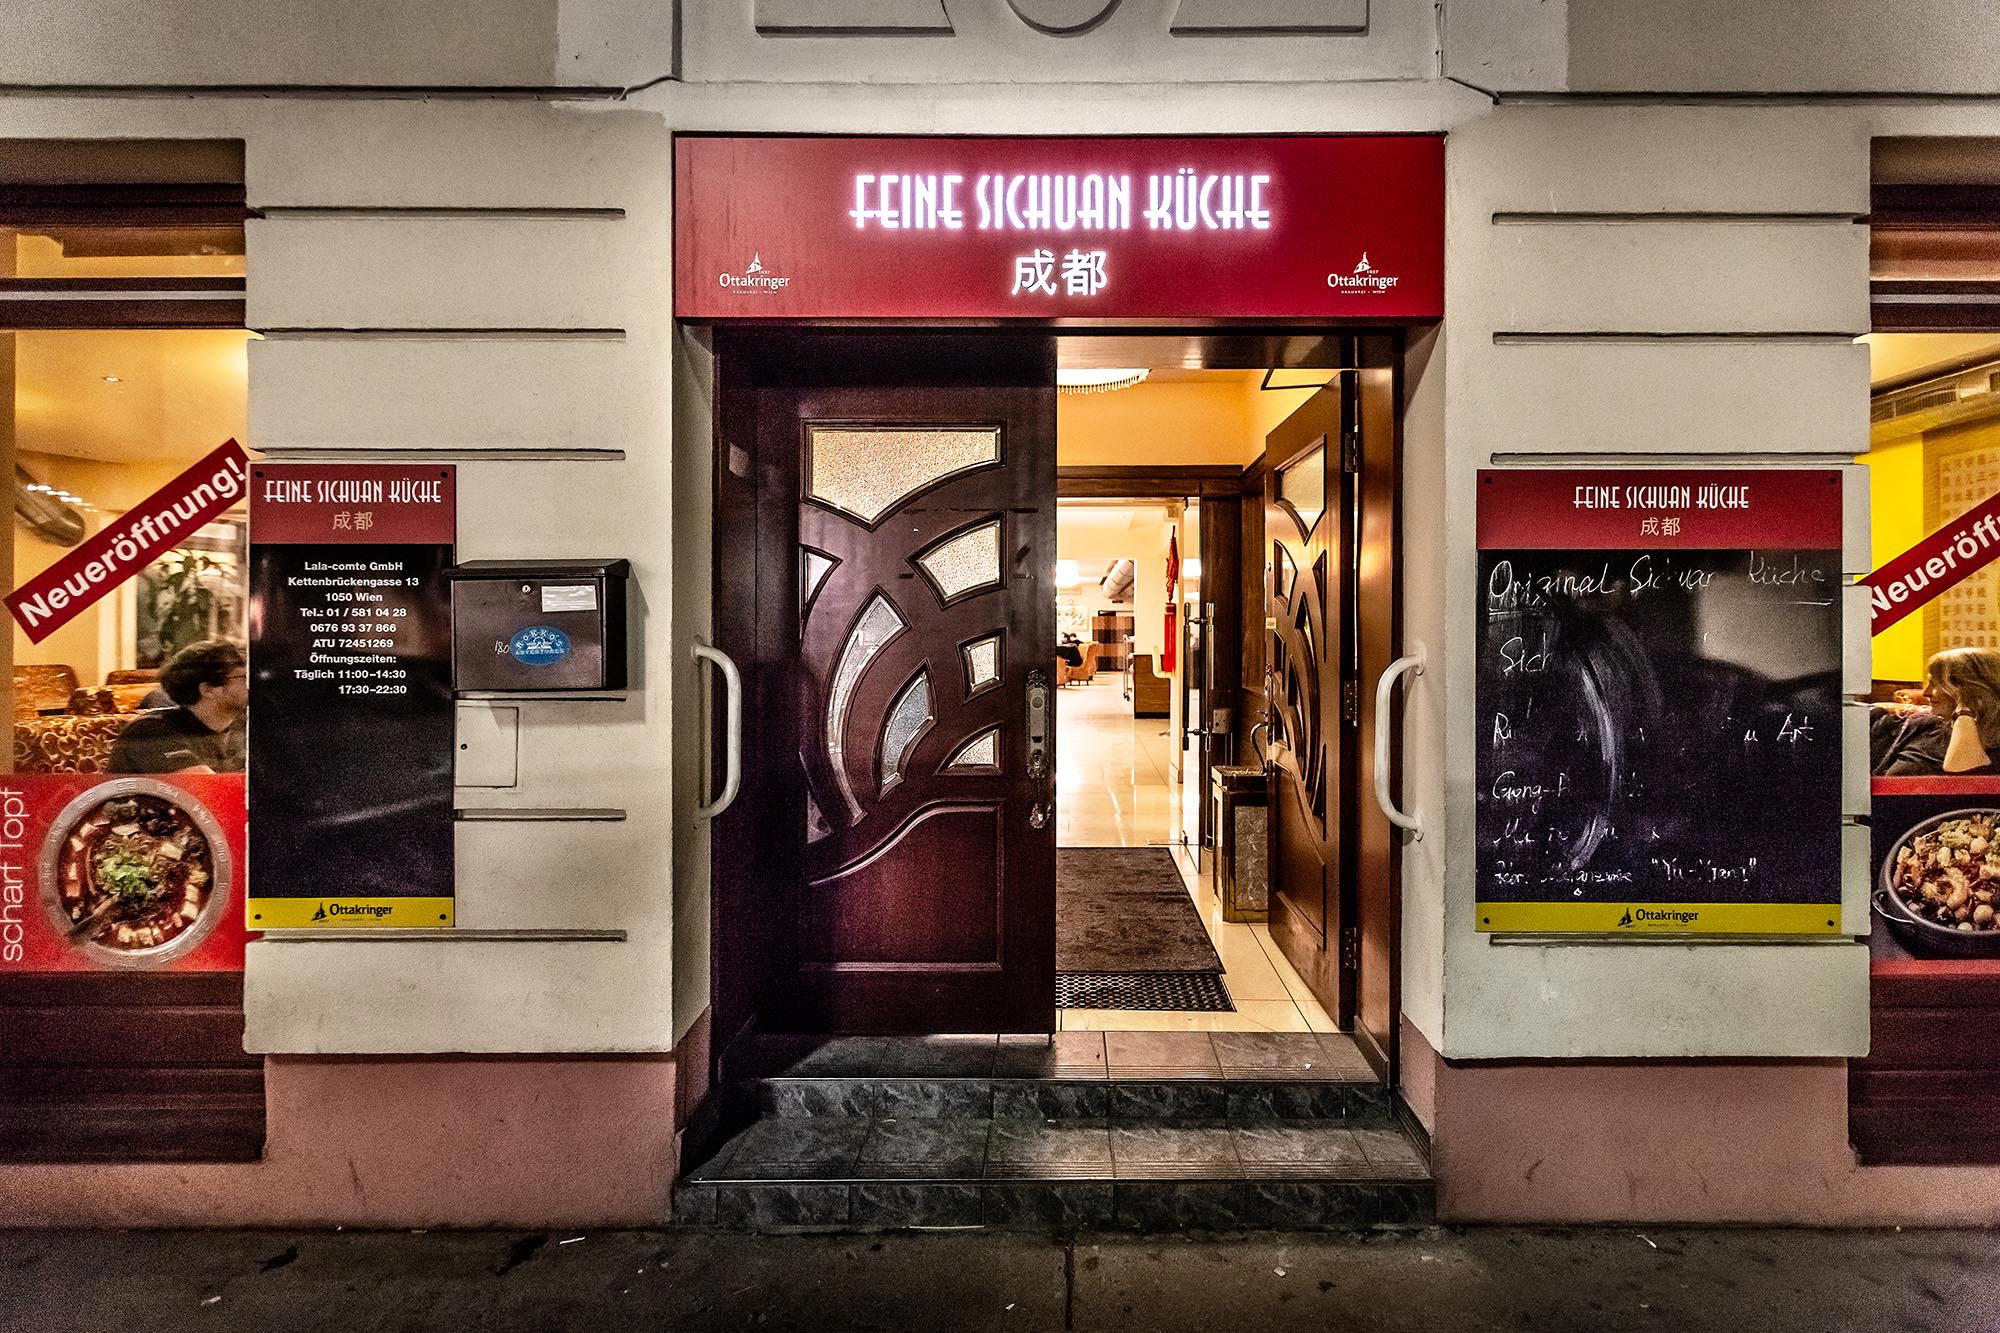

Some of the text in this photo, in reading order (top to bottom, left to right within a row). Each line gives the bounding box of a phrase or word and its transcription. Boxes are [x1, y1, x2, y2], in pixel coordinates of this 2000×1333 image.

[849, 167, 1270, 229] FEINE SICHUAN KÜCHE
[1011, 248, 1108, 296] 成都
[719, 273, 791, 290] Ottakringer
[1327, 273, 1399, 290] Ottakringer
[264, 477, 441, 502] FEINE SICHUAN KÜCHE
[1573, 483, 1749, 509] FEINE SICHUAN KÜCHE
[332, 511, 373, 530] 成都
[1640, 517, 1681, 536] 成都
[18, 457, 247, 627] Neueröffnung!
[304, 562, 403, 571] Lala-comte GmbH
[1872, 514, 2000, 619] Neueröff
[288, 577, 419, 588] Kettenbrückengasse 13
[325, 593, 383, 601] 1050 Wien
[300, 608, 324, 617] Tel.:
[326, 608, 340, 617] 01
[351, 608, 371, 617] 581
[375, 608, 389, 617] 04
[393, 608, 407, 617] 28
[310, 624, 397, 632] 0676 93 37 866
[313, 639, 394, 648] ATU 72451269
[310, 652, 397, 665] Öffnungszeiten:
[294, 670, 335, 681] Täglich
[329, 904, 393, 917] Ottakringer
[1635, 908, 1699, 923] Ottakringer
